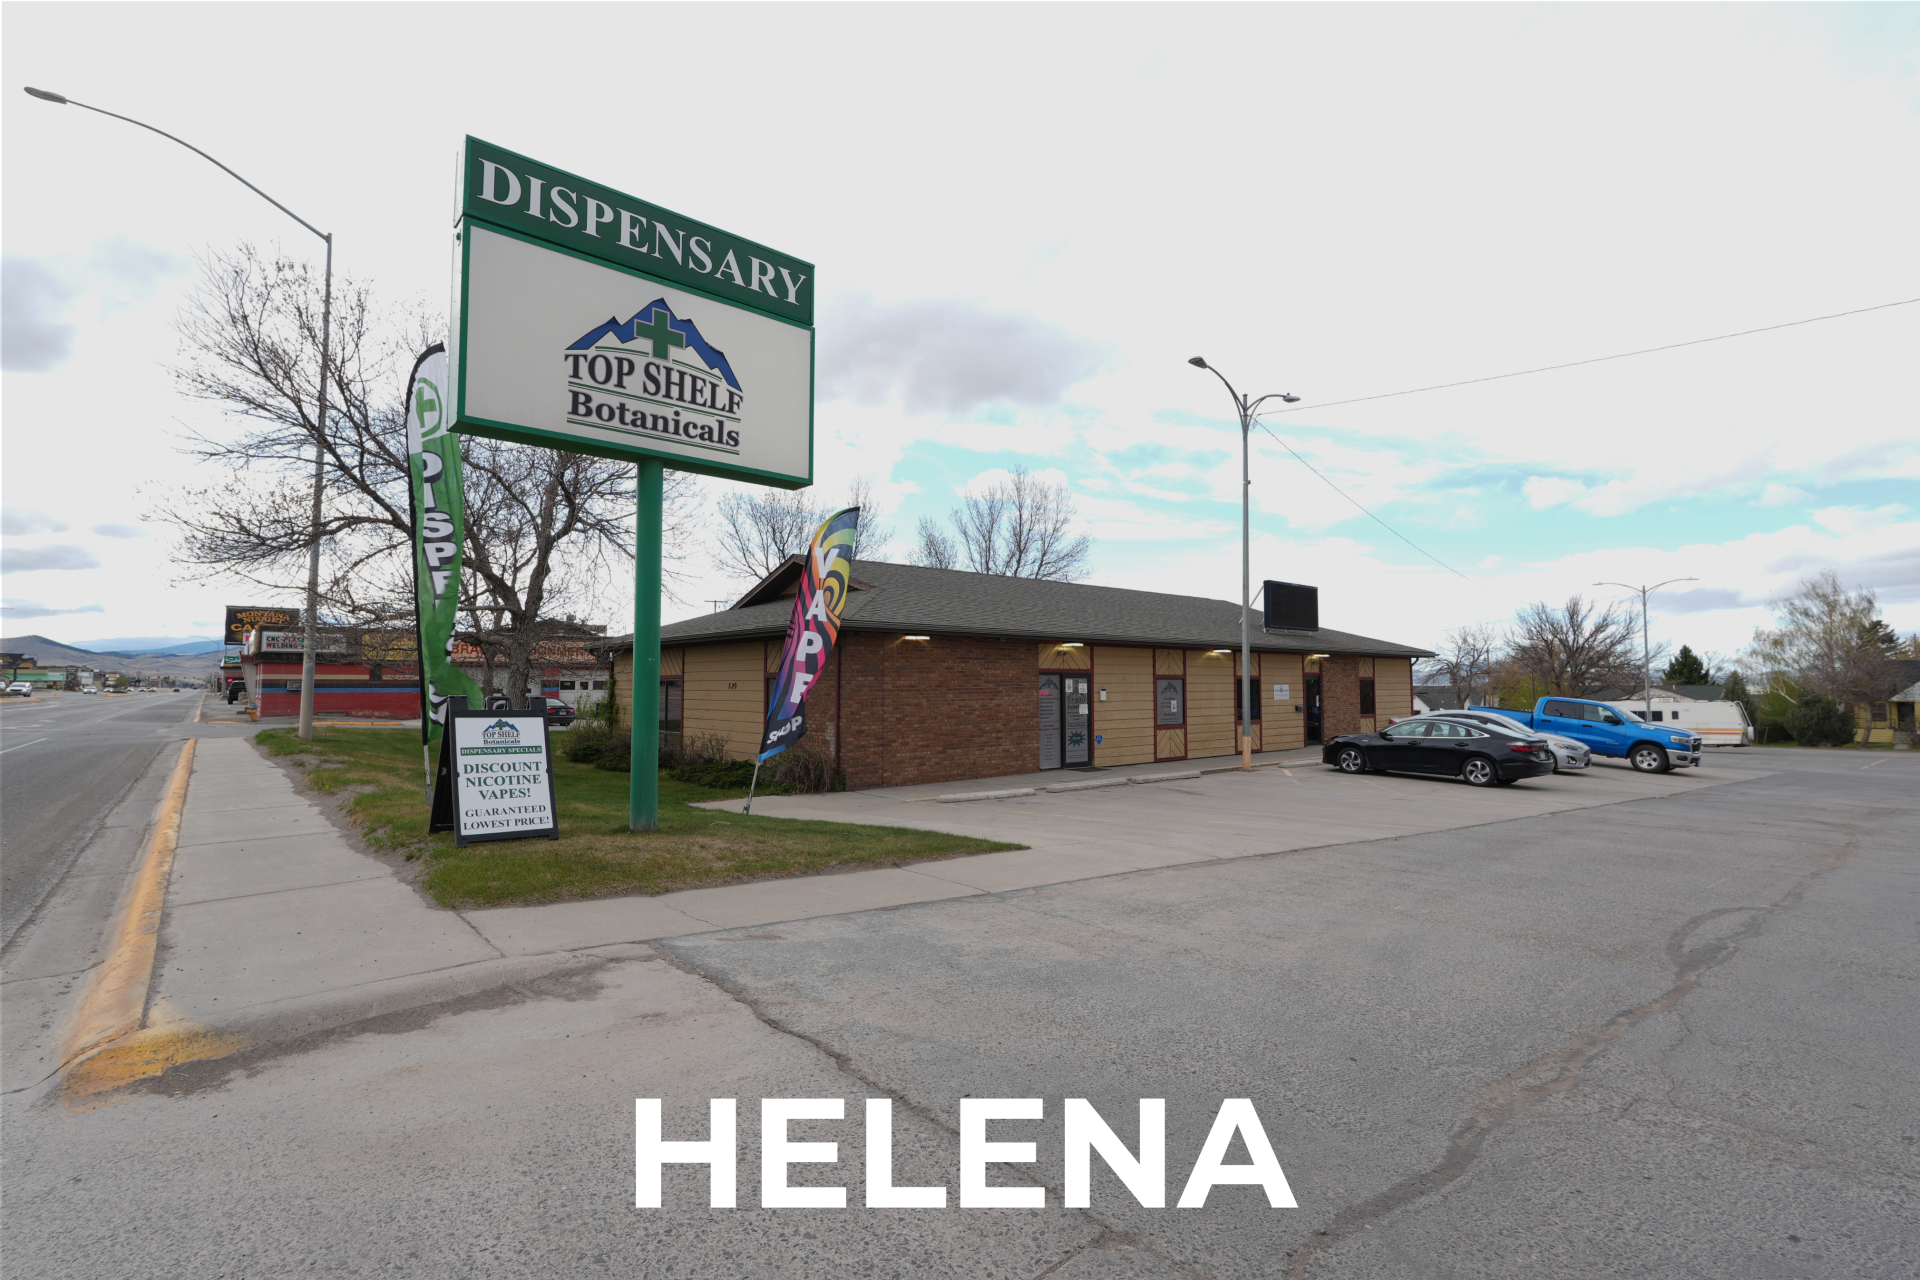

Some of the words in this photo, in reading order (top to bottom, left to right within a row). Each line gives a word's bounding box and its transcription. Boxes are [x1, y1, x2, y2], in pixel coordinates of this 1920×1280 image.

[476, 157, 807, 306] DISPENSARY
[564, 353, 635, 390] TOP
[642, 361, 743, 416] SHELF
[567, 389, 740, 448] Botanicals
[790, 546, 839, 704] VAPE
[482, 731, 497, 739] TOP
[497, 730, 521, 739] SHELF
[766, 715, 803, 744] SHOP
[461, 747, 507, 755] DISPENSARY
[507, 746, 542, 754] SPECIALS
[463, 761, 542, 774] DISCOUNT
[465, 774, 542, 788] NICOTINE
[478, 787, 531, 800] VAPES!
[465, 804, 546, 818] GUARANTEED
[463, 819, 511, 831] LOWEST
[514, 816, 550, 827] PRICE!
